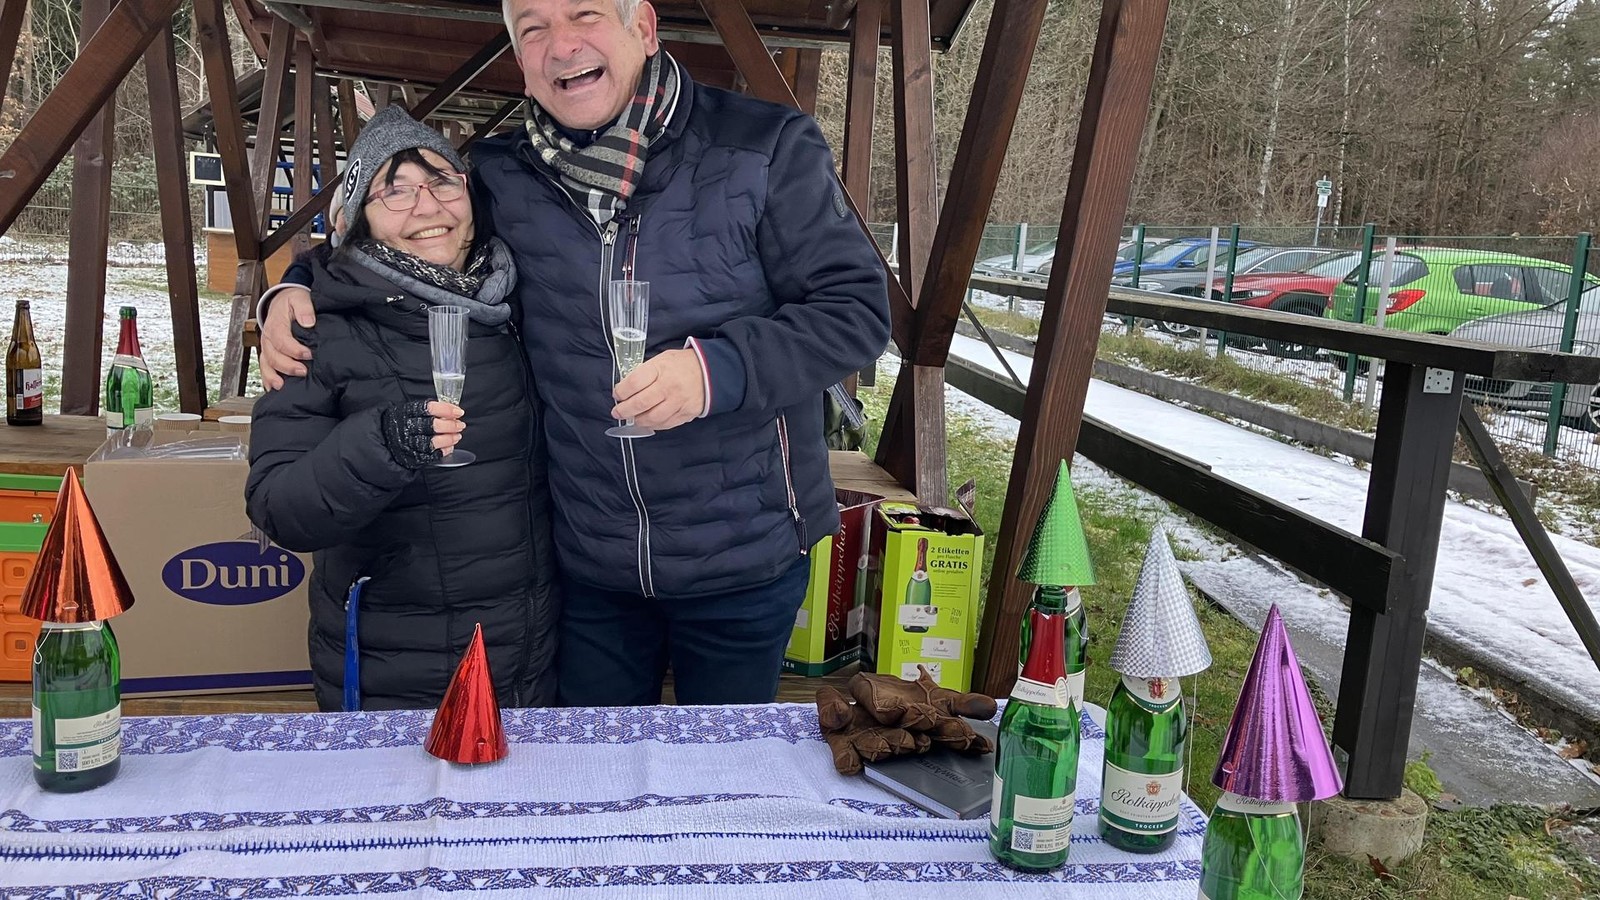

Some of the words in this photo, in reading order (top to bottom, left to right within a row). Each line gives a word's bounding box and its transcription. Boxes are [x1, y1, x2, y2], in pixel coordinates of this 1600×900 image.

[937, 547, 970, 555] Etiketten
[180, 554, 290, 590] Duni
[930, 560, 968, 569] GRATIS
[827, 522, 847, 641] Rotkäppchen
